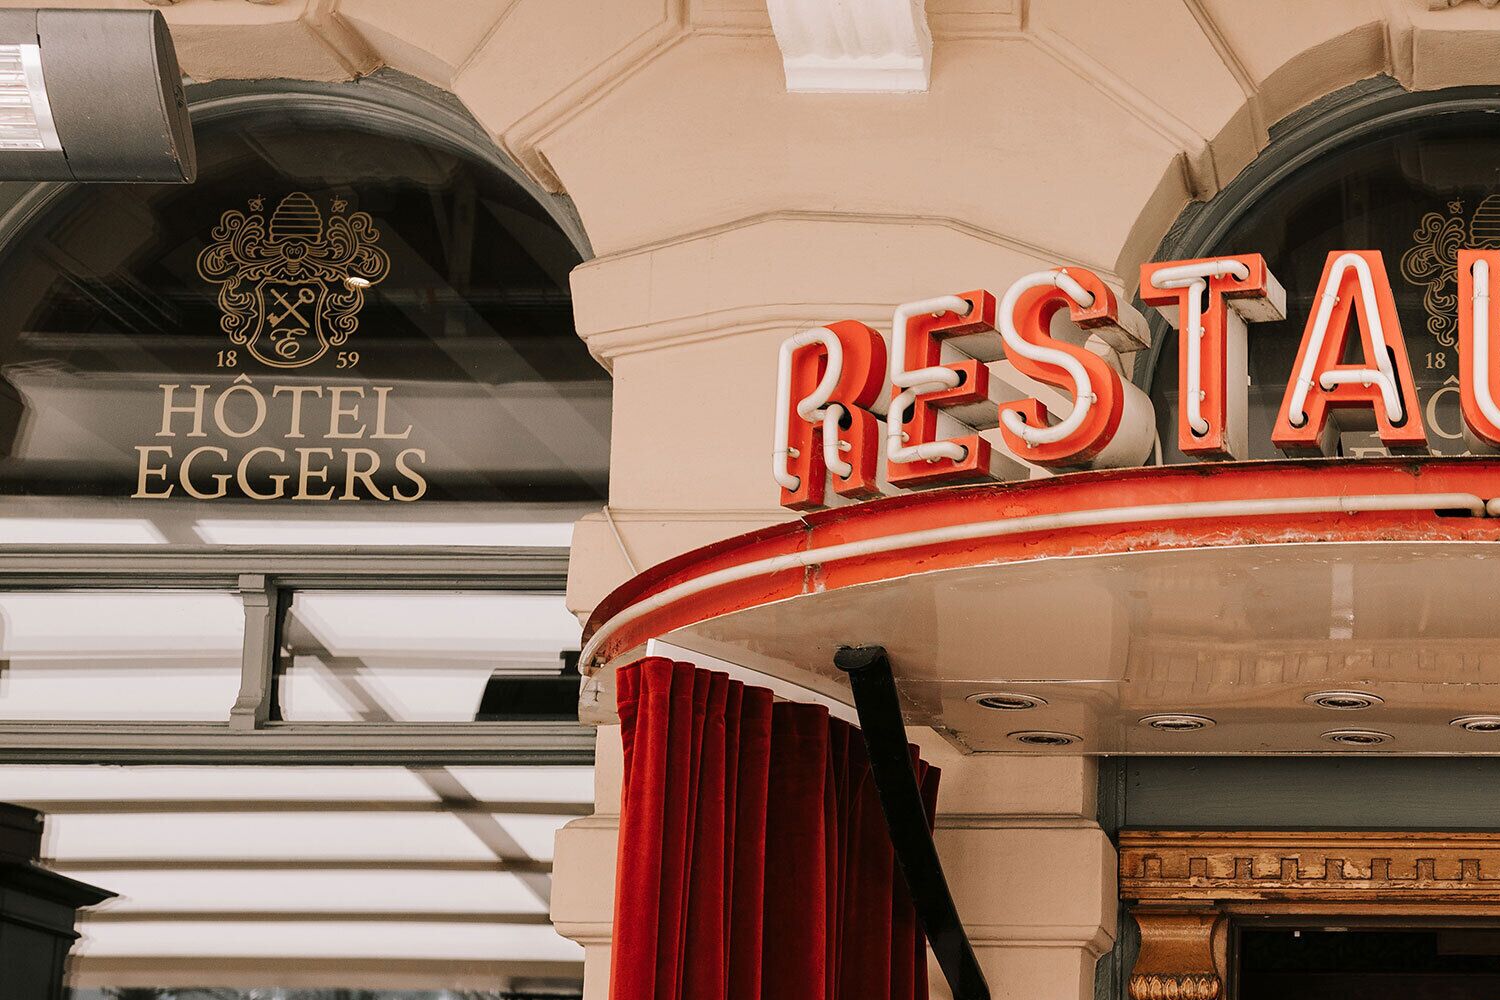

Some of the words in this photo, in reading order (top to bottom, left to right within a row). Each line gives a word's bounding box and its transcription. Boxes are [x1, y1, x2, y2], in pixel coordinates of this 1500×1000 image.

[216, 350, 238, 368] 18
[336, 351, 360, 369] 59
[1425, 352, 1446, 369] 18
[154, 373, 413, 440] HÔTEL
[131, 445, 428, 502] EGGERS
